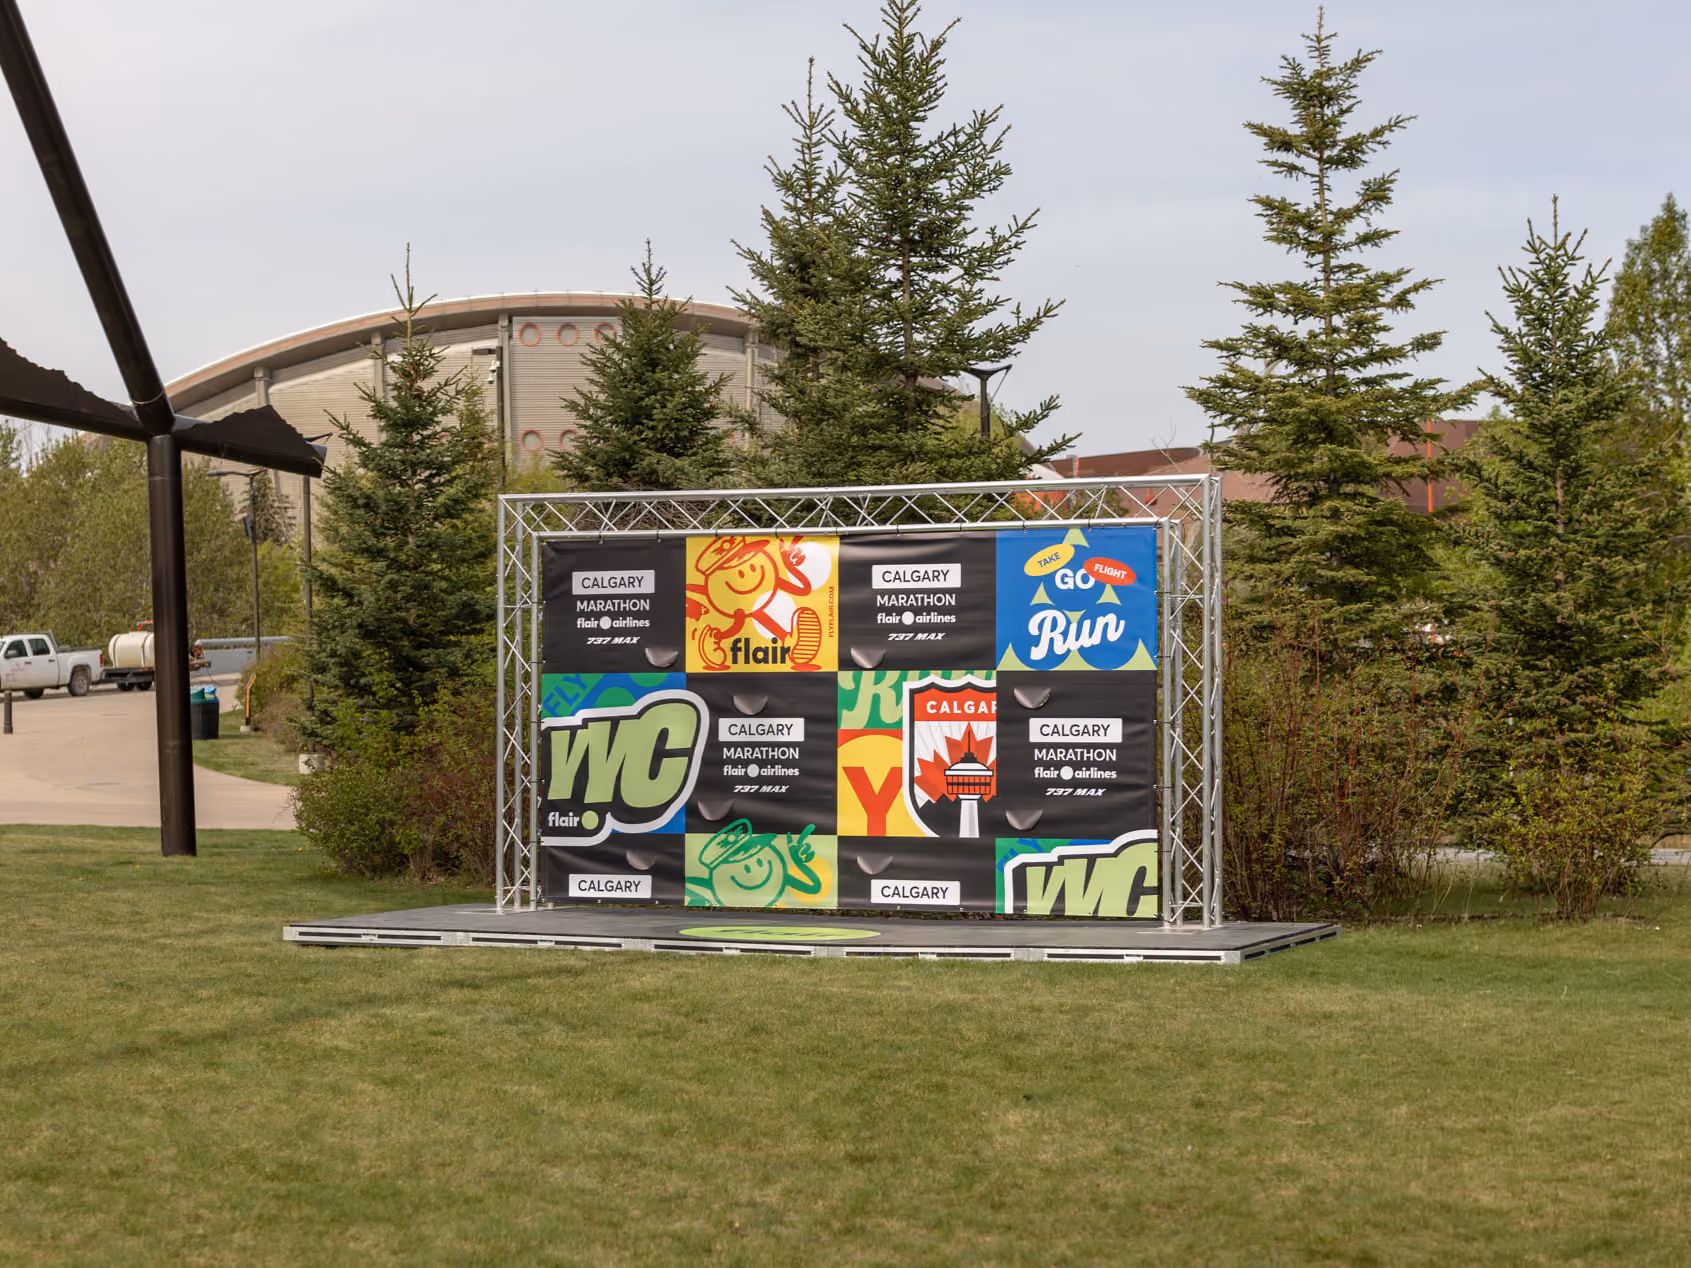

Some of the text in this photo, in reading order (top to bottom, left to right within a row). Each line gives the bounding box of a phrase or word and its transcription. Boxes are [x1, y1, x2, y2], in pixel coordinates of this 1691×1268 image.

[1037, 552, 1061, 568] TAKE
[881, 569, 950, 583] CALGARY
[1094, 563, 1128, 579] FLIGHT
[581, 575, 644, 589] CALGARY
[1055, 568, 1096, 590] GO
[576, 598, 650, 612] MARATHON
[876, 593, 956, 607] MARATHON
[576, 616, 650, 629] flair airlines
[876, 611, 957, 624] flair airlines
[586, 636, 641, 645] 737 MAX
[887, 632, 946, 641] 737 MAX
[1028, 609, 1126, 661] Run
[730, 637, 791, 665] flair
[728, 723, 794, 737] CALGARY
[1039, 723, 1111, 737] CALGARY
[722, 747, 799, 760] MARATHON
[1034, 748, 1117, 762] MARATHON
[723, 764, 800, 776] flair airlines
[1034, 766, 1117, 779] flair airlines
[733, 785, 790, 793] 737 MAX
[1045, 787, 1107, 796] 737 MAX
[547, 810, 580, 828] flair
[577, 879, 642, 893] CALGARY
[880, 885, 949, 900] CALGARY
